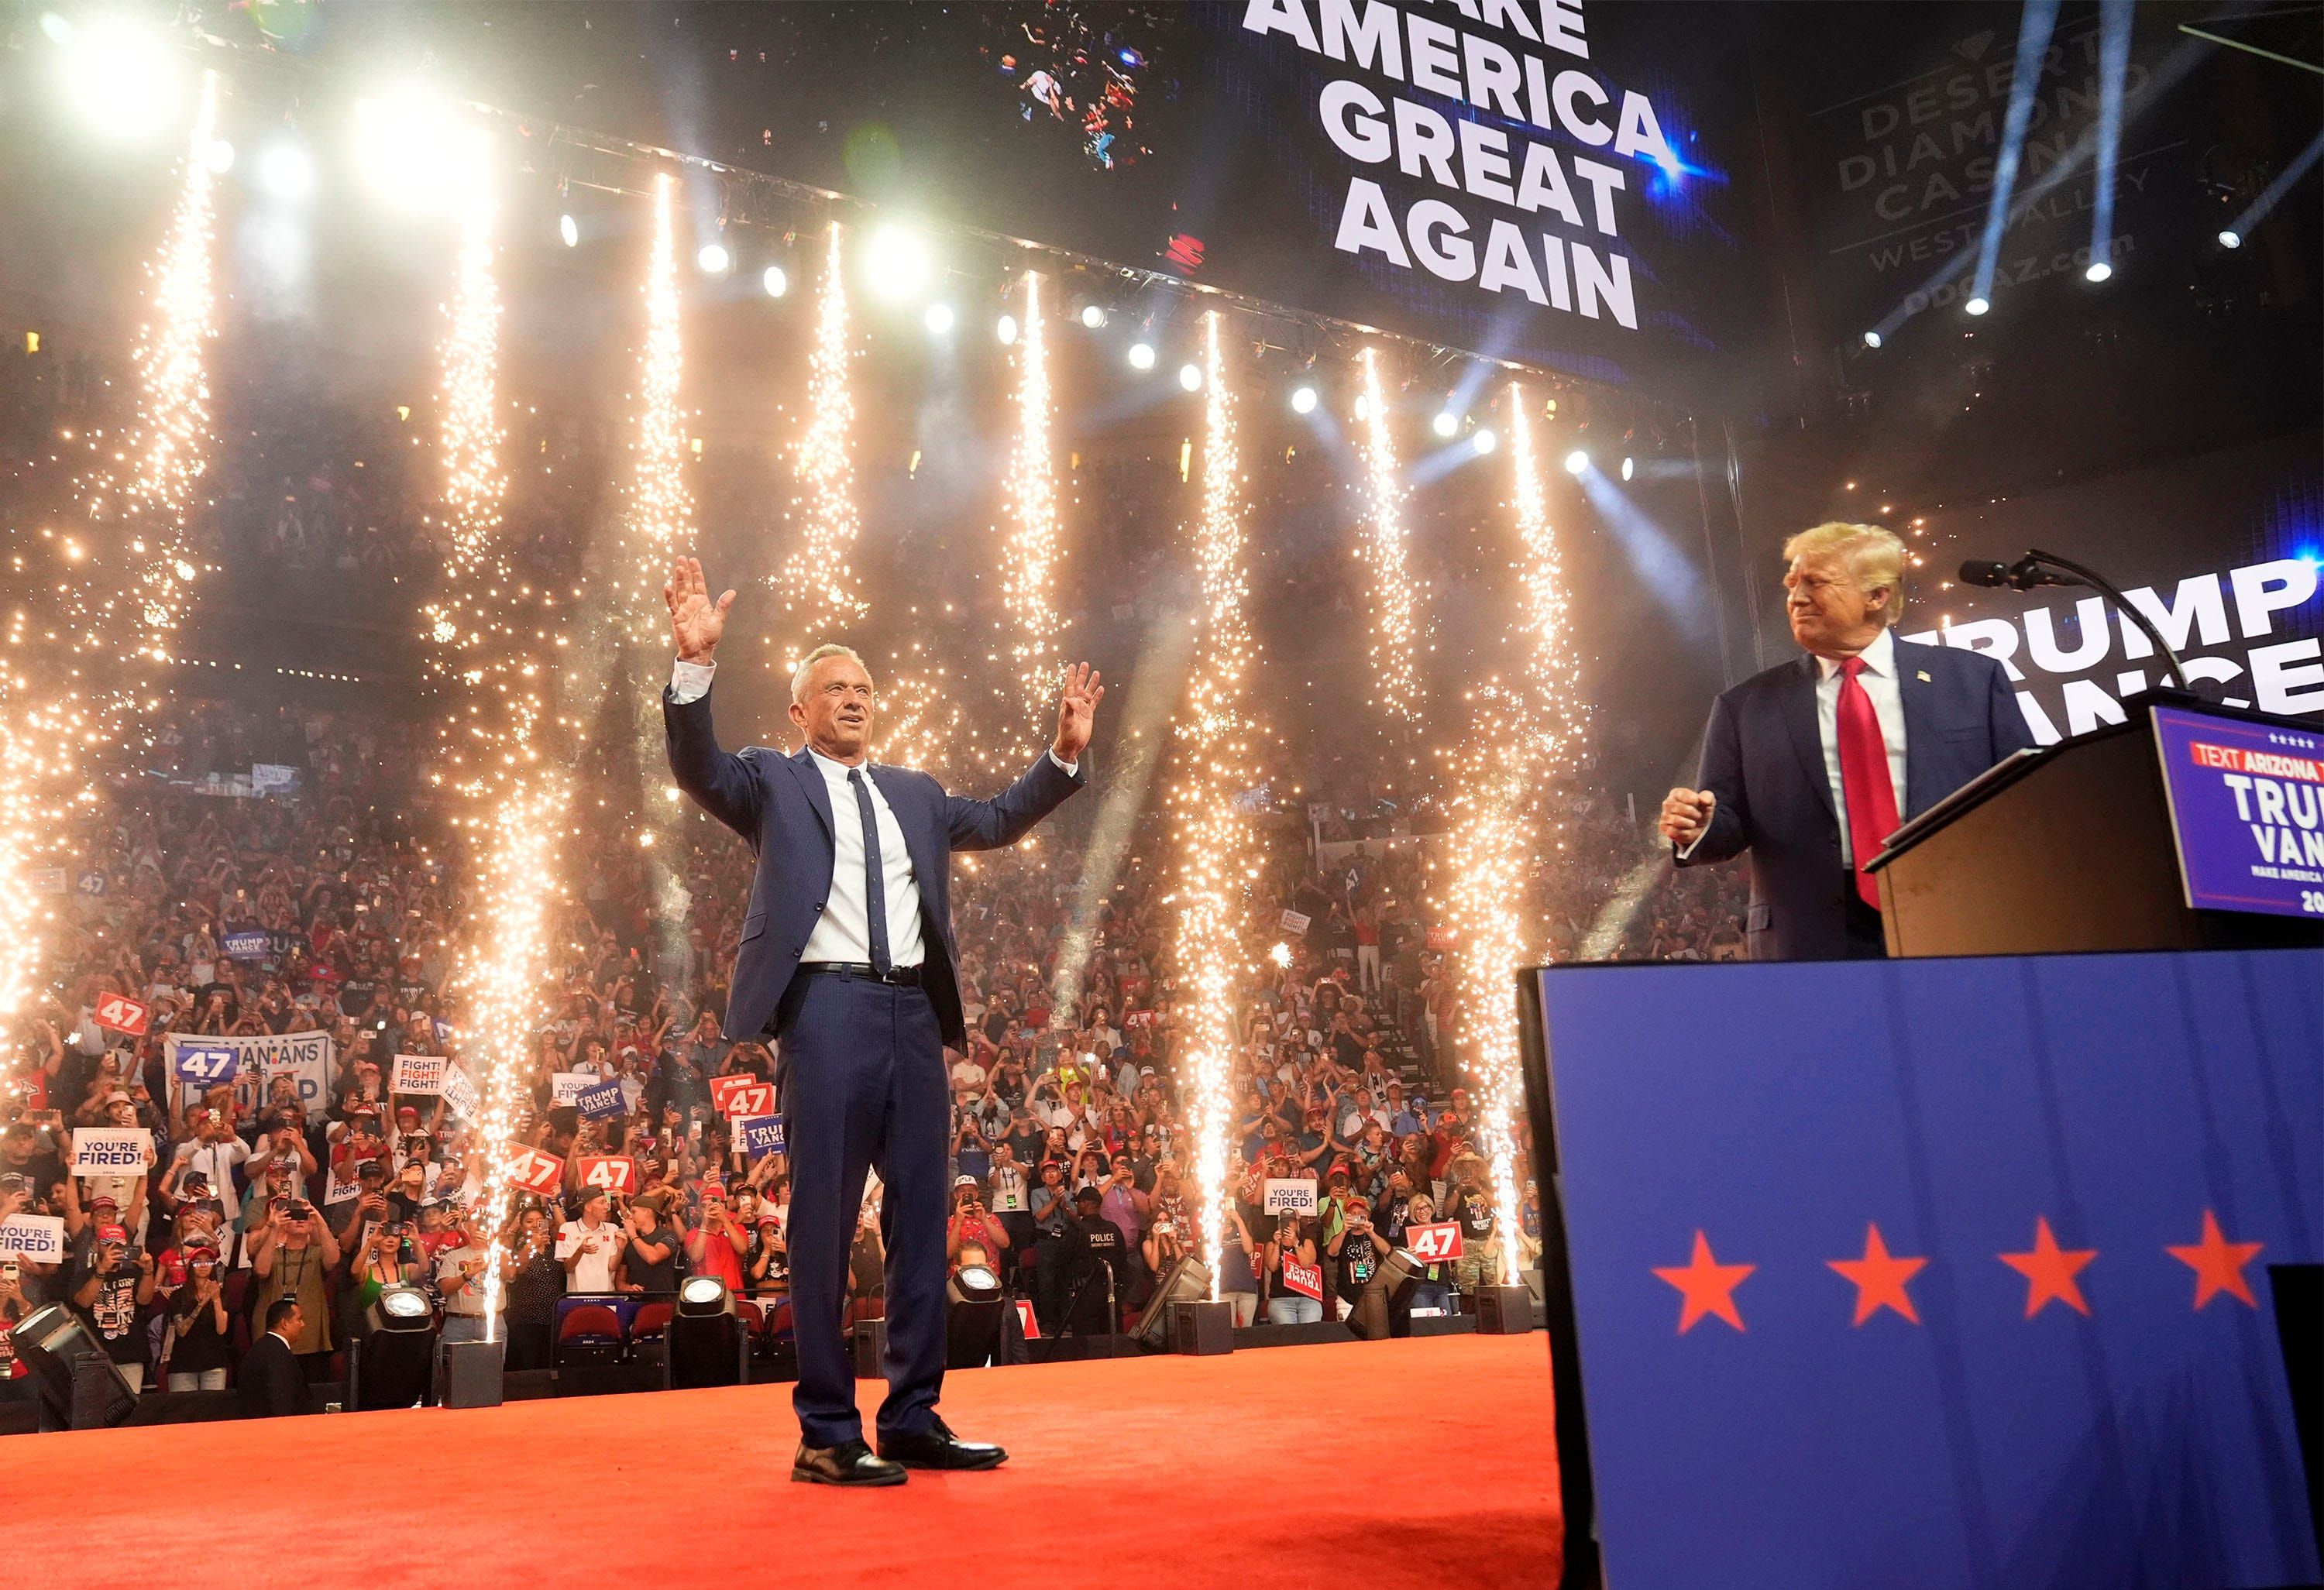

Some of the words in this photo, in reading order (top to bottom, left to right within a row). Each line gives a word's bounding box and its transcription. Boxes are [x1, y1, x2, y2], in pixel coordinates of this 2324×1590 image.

[1242, 0, 1675, 169] AMERICA
[1319, 80, 1625, 236] GREAT
[1335, 177, 1638, 330] AGAIN
[1869, 222, 1977, 273] WEST
[2195, 743, 2240, 770] TEXT
[2245, 750, 2320, 781] ARIZONA
[2223, 773, 2324, 830] TRU
[79, 875, 104, 893] 47
[2251, 865, 2279, 880] MAKE
[2281, 868, 2323, 884] AMERICA
[225, 937, 263, 947] TRUMP
[101, 1000, 143, 1027] 47
[181, 1052, 231, 1077] 47
[401, 1070, 439, 1080] FIGHT!
[402, 1060, 440, 1070] FIGHT!
[399, 1079, 438, 1089] FIGHT!
[578, 1087, 619, 1108] TRUMP
[583, 1096, 617, 1112] VANCE
[728, 1087, 767, 1114] 47
[84, 1142, 138, 1152] YOU'RE
[78, 1152, 142, 1165] FIRED!
[510, 1152, 556, 1187] 47
[586, 1160, 630, 1188] 47
[1270, 1197, 1312, 1207] FIRED!
[0, 1227, 52, 1238] YOU'RE
[1090, 1233, 1114, 1242] POLICE
[1415, 1228, 1456, 1257] 47
[1285, 1271, 1320, 1292] TRUMP
[1290, 1265, 1317, 1282] VANCE
